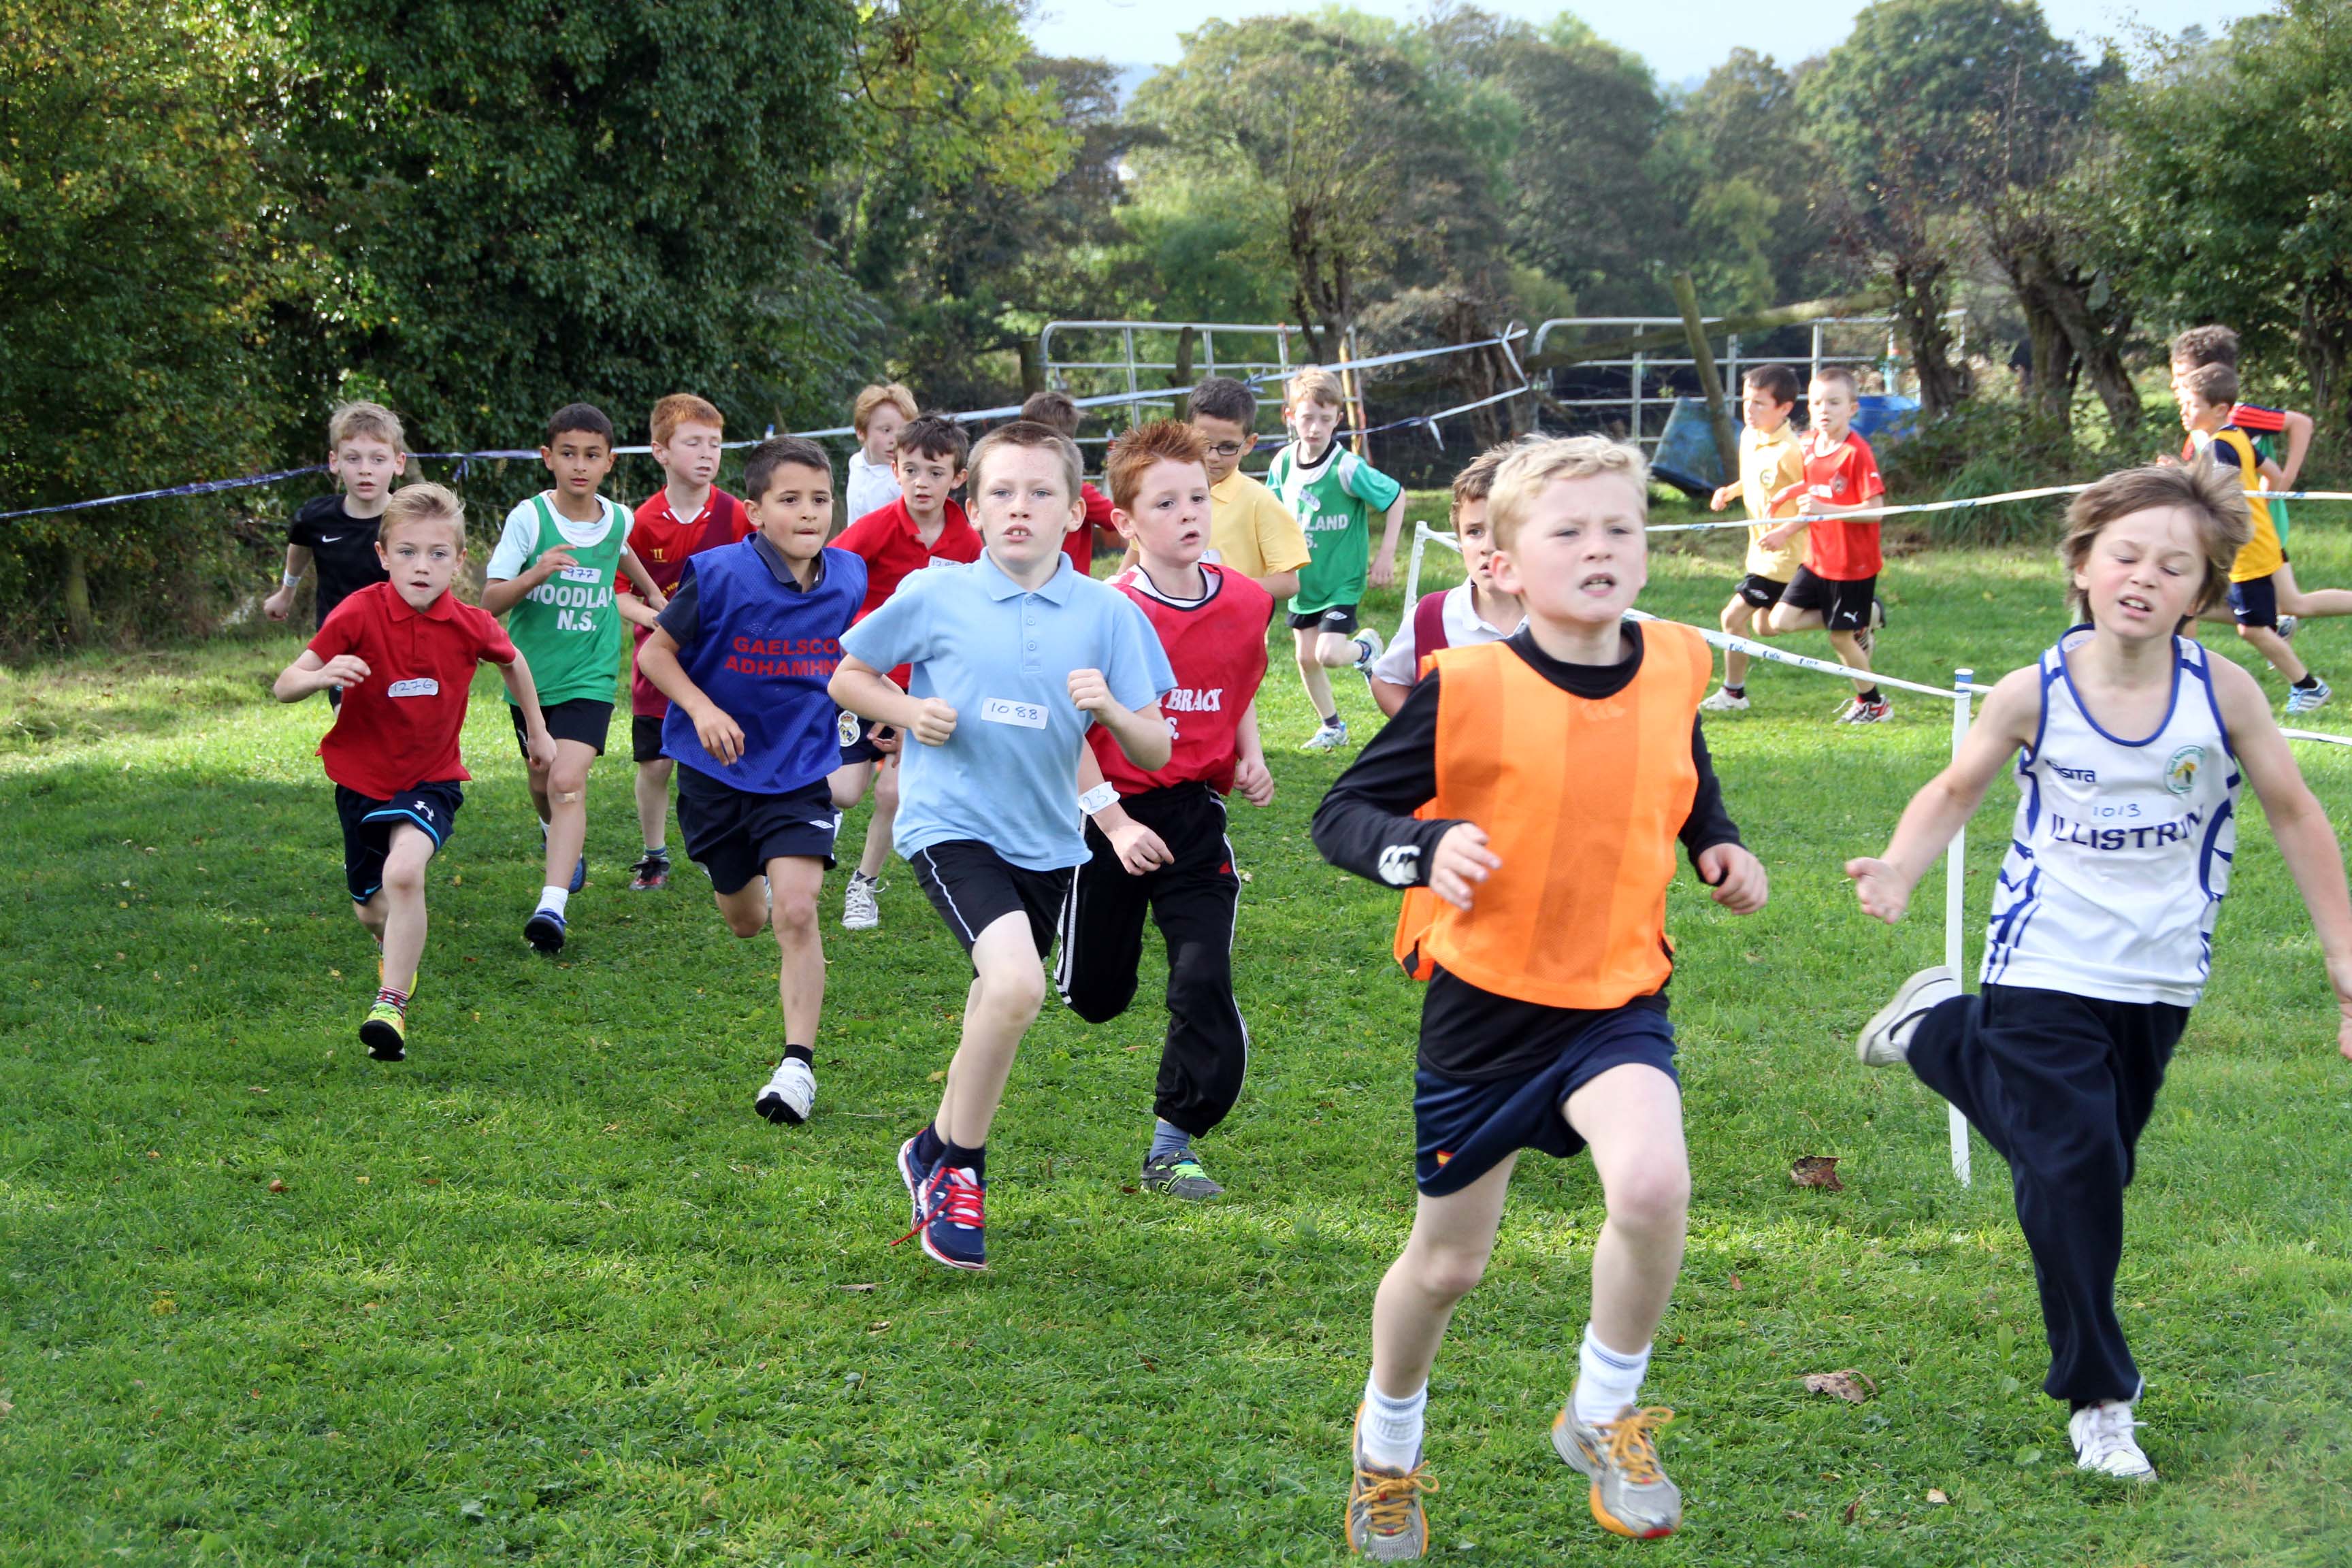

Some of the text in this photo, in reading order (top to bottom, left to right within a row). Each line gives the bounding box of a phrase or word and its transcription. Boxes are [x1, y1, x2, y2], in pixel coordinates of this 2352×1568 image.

[566, 568, 593, 578] 977
[557, 608, 597, 632] N.S.
[733, 636, 839, 655] GAELSCO
[724, 655, 839, 676] ADHAMHN
[394, 679, 433, 691] 1276
[991, 702, 1038, 720] 1088
[2093, 803, 2142, 817] 1013
